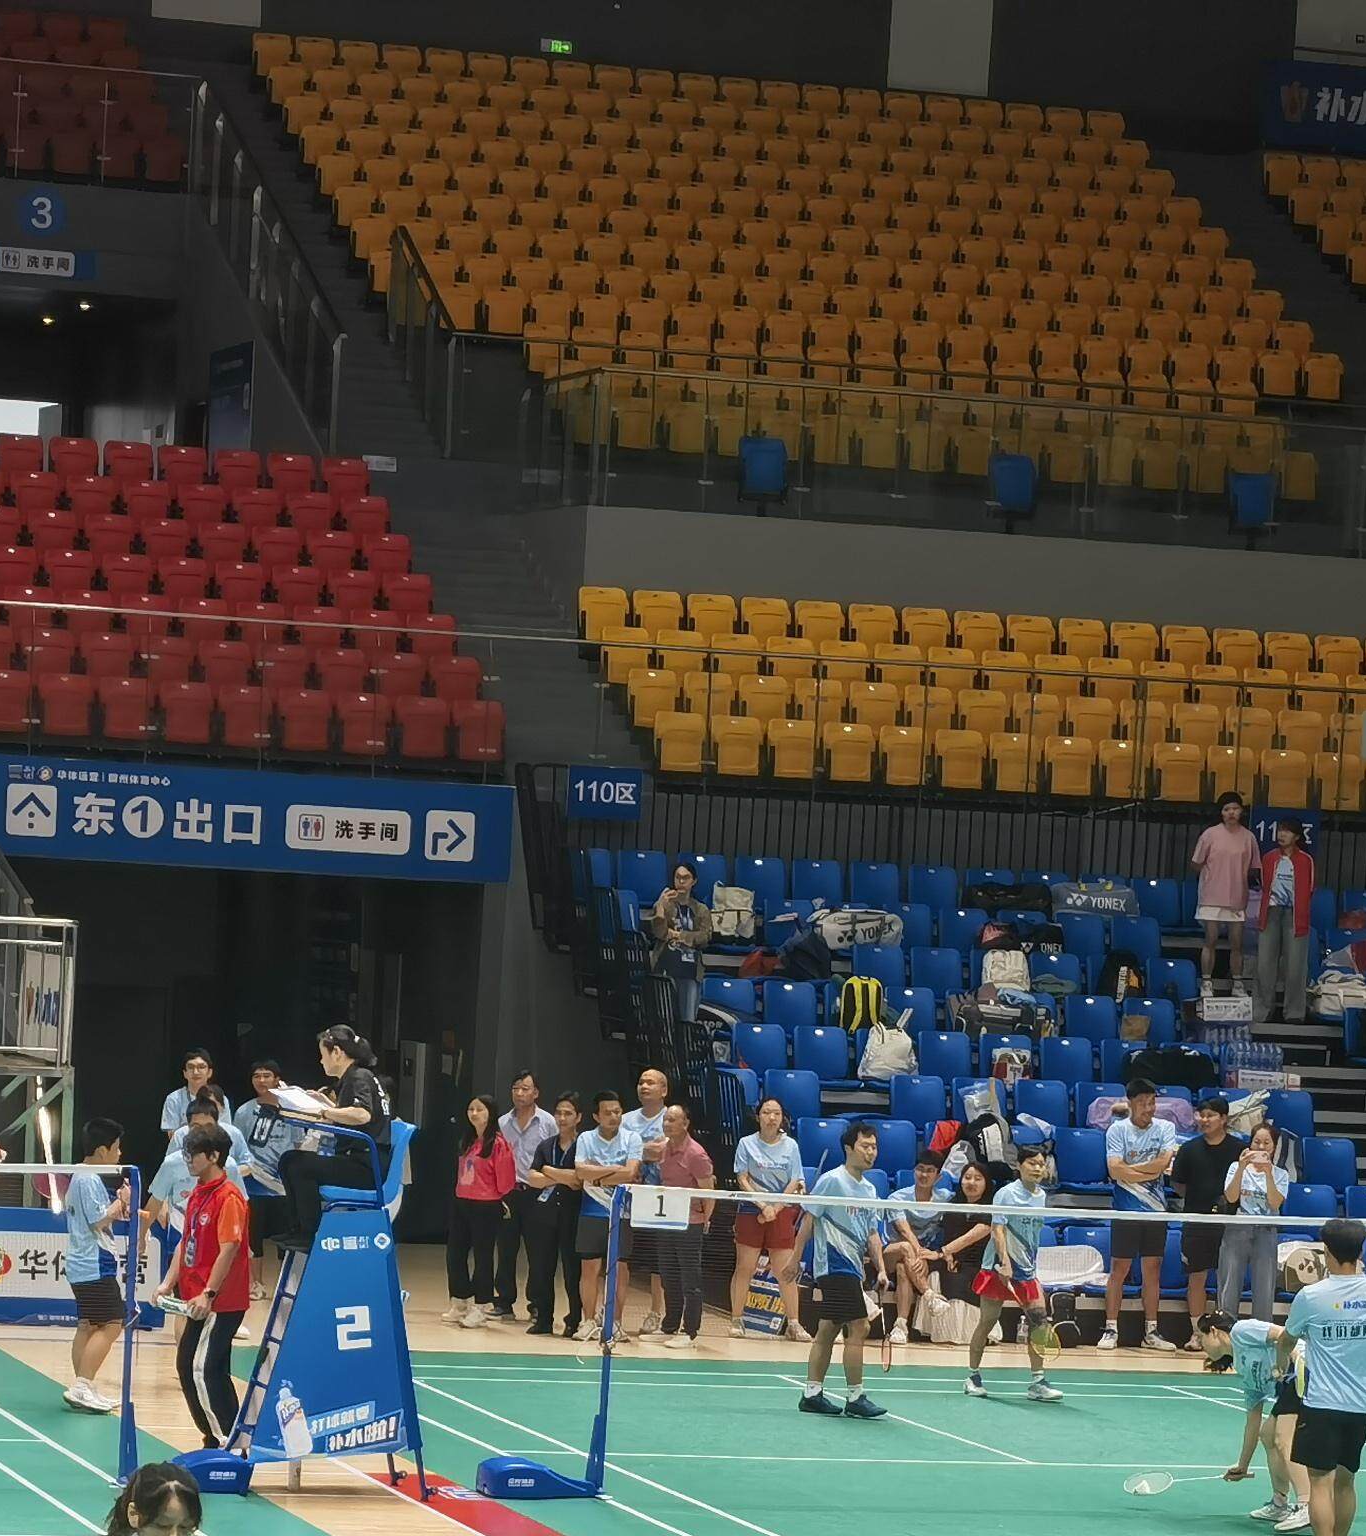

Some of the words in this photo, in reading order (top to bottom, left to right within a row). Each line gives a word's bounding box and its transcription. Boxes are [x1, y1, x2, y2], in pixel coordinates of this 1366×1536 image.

[30, 196, 52, 230] 3
[574, 780, 637, 806] 110区
[334, 818, 400, 843] 洗手间
[1089, 895, 1127, 912] YONEX
[860, 922, 895, 942] YONEX
[654, 1193, 667, 1218] 1
[335, 1305, 372, 1351] 2
